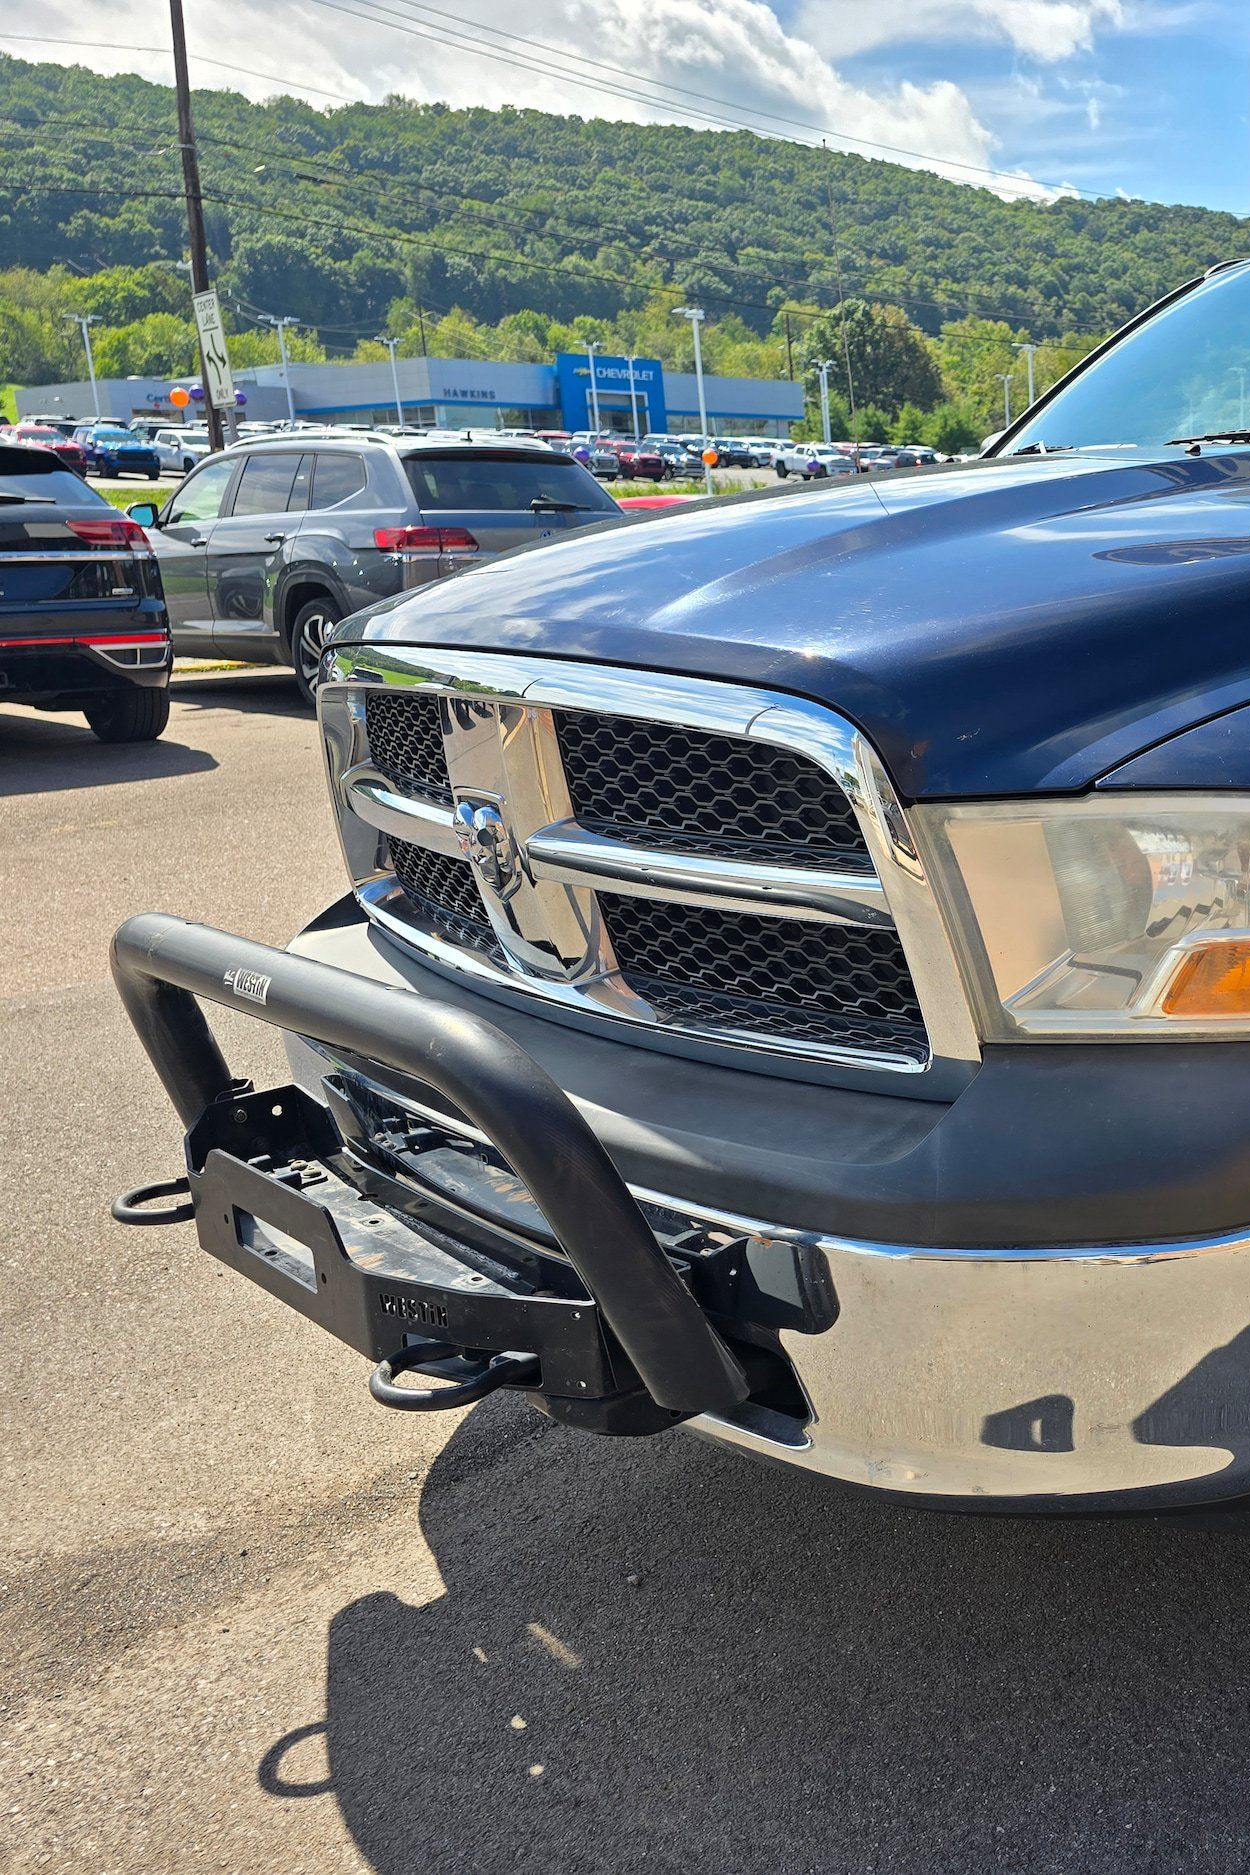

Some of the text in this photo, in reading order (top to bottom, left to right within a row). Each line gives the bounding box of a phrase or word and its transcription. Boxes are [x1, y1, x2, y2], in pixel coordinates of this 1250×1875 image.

[196, 298, 216, 313] CENTER
[202, 312, 216, 327] LANE
[596, 367, 655, 381] CHEVROLET
[216, 388, 229, 400] ONLY
[443, 388, 496, 400] HAWKINS
